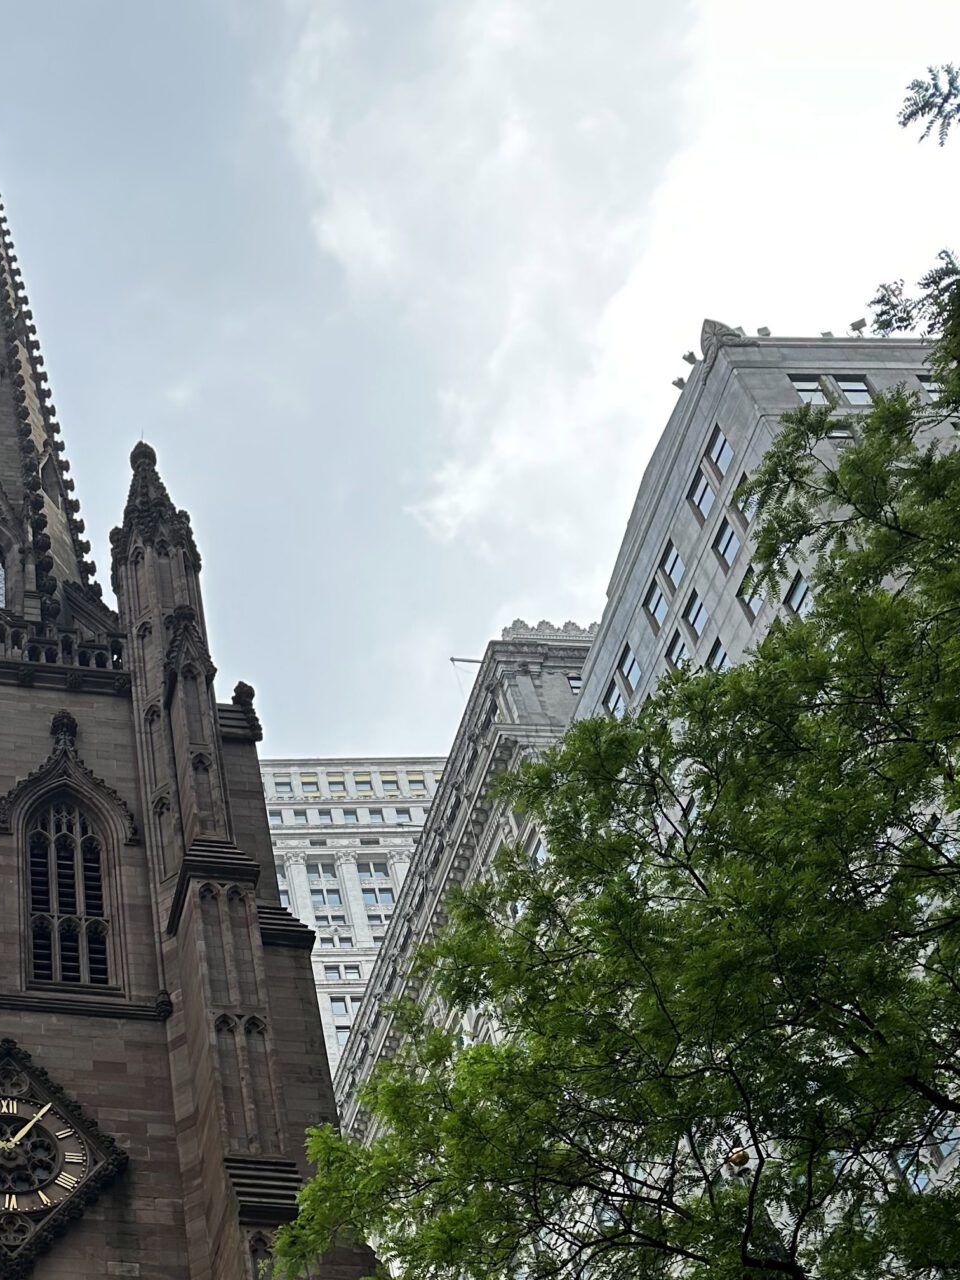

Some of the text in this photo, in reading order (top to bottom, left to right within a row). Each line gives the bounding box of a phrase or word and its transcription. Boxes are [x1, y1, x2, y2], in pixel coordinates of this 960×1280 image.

[0, 1100, 17, 1114] XII
[55, 1129, 74, 1139] II
[64, 1152, 83, 1163] III
[54, 1171, 78, 1190] IIII
[4, 1194, 18, 1210] VI
[37, 1190, 51, 1205] V
